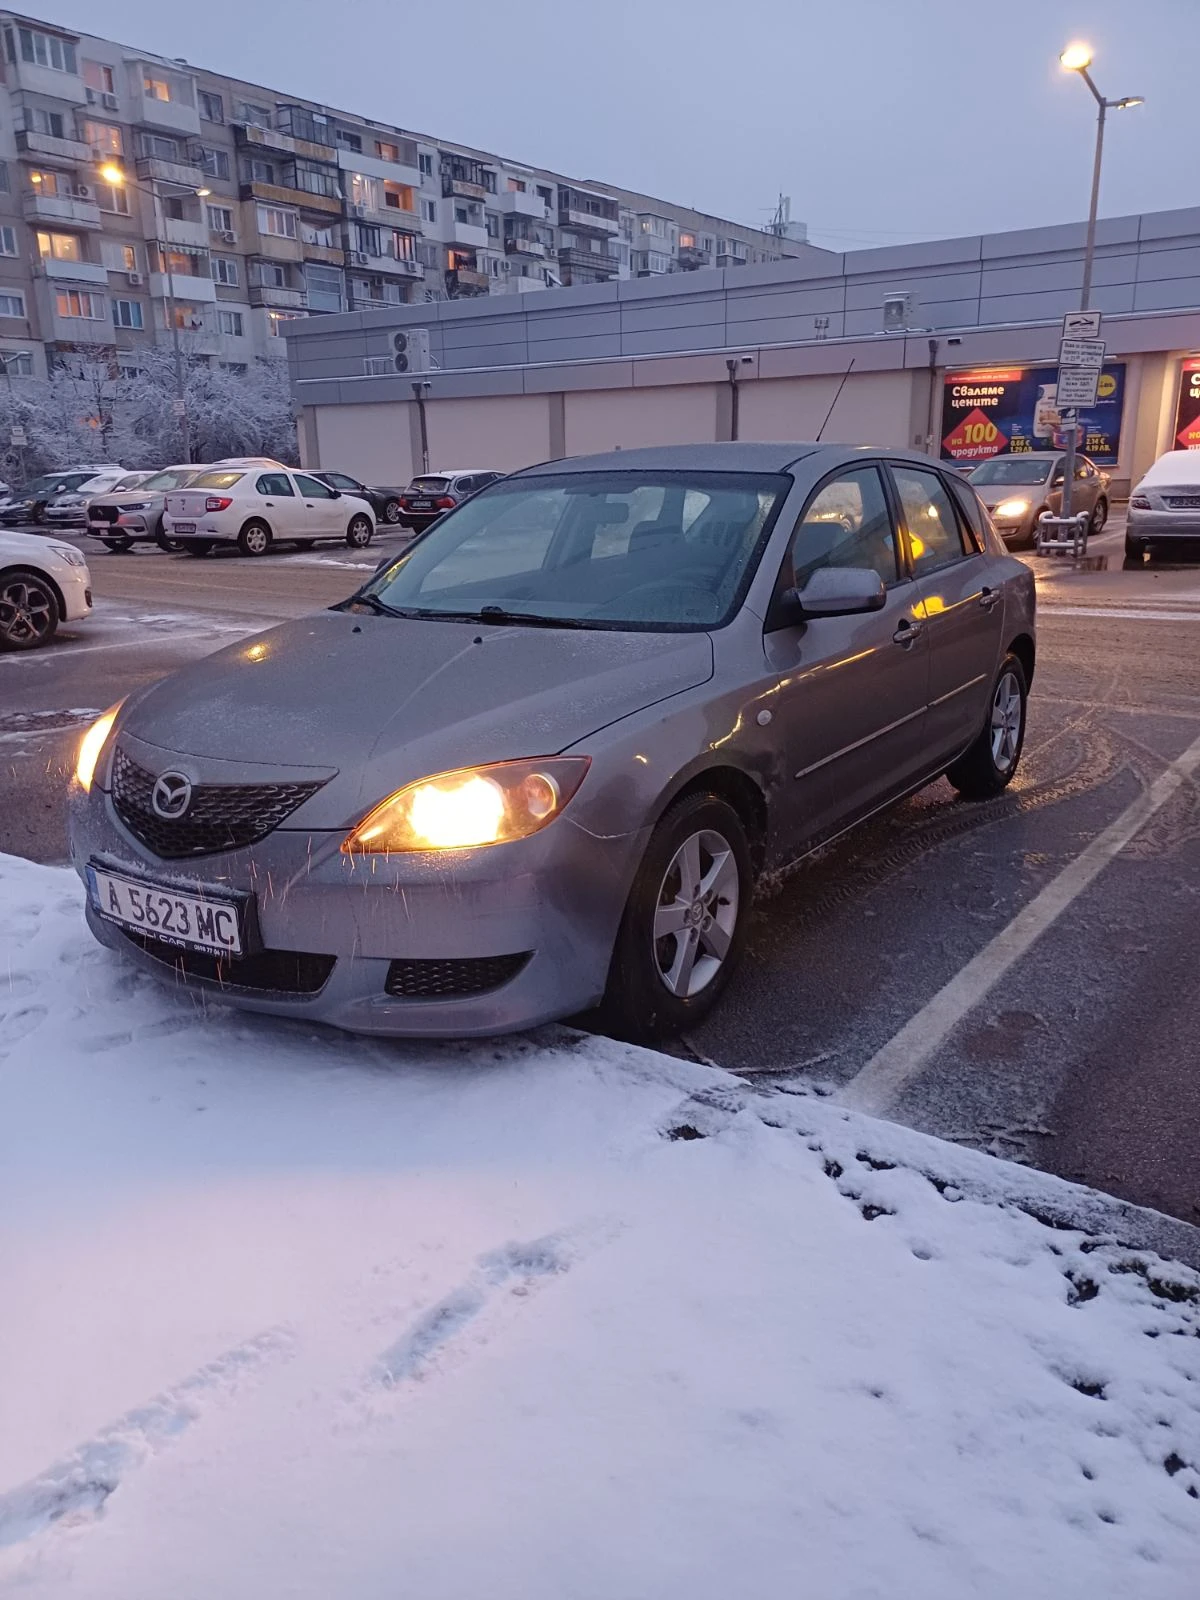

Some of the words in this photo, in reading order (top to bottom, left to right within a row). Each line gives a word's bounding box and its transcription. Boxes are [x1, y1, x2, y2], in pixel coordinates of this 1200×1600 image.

[952, 386, 1005, 397] Сваляме
[951, 398, 999, 408] цените
[964, 422, 998, 443] 100
[950, 445, 999, 458] продукта
[128, 888, 191, 936] 5623
[159, 934, 186, 949] CAR
